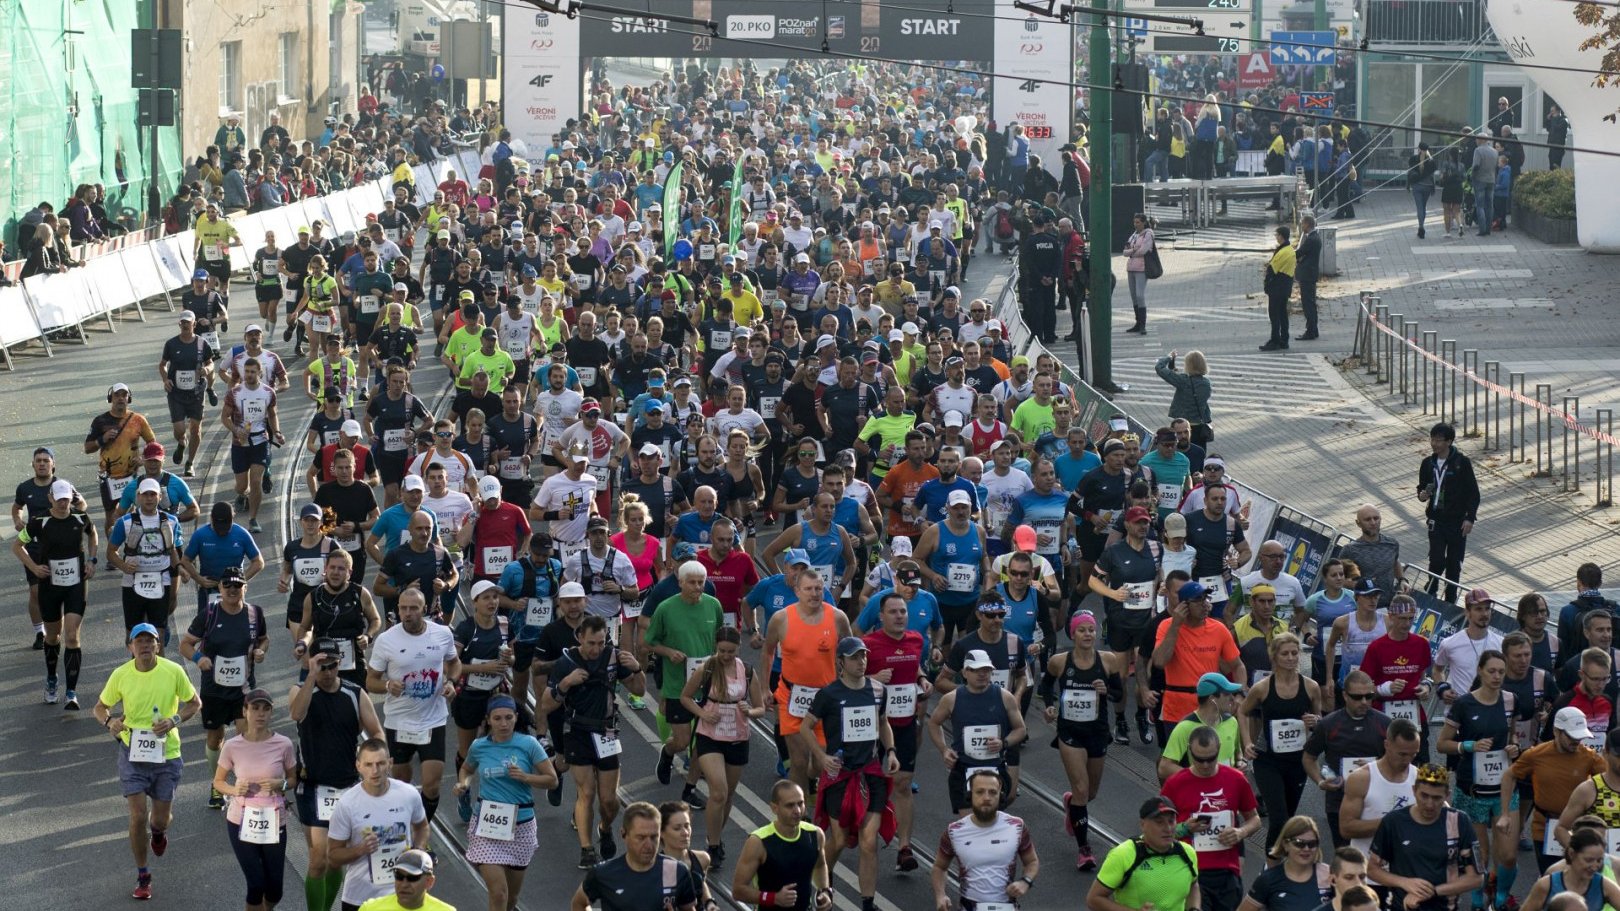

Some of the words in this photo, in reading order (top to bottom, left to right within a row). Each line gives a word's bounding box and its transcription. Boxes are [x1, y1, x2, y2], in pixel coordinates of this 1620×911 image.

[610, 16, 671, 33] START
[730, 22, 746, 32] 20.
[748, 22, 771, 32] PKO
[900, 18, 960, 34] START
[1218, 38, 1239, 52] 75
[1246, 54, 1270, 73] A
[526, 106, 556, 115] VERONI
[54, 568, 75, 576] 4234
[954, 572, 970, 580] 2719
[890, 696, 912, 704] 2854
[1068, 701, 1091, 709] 3433
[849, 718, 871, 728] 1888
[1278, 731, 1300, 740] 5827
[138, 740, 156, 749] 708
[1484, 763, 1502, 772] 1741
[483, 813, 508, 826] 4865
[248, 820, 269, 830] 5732
